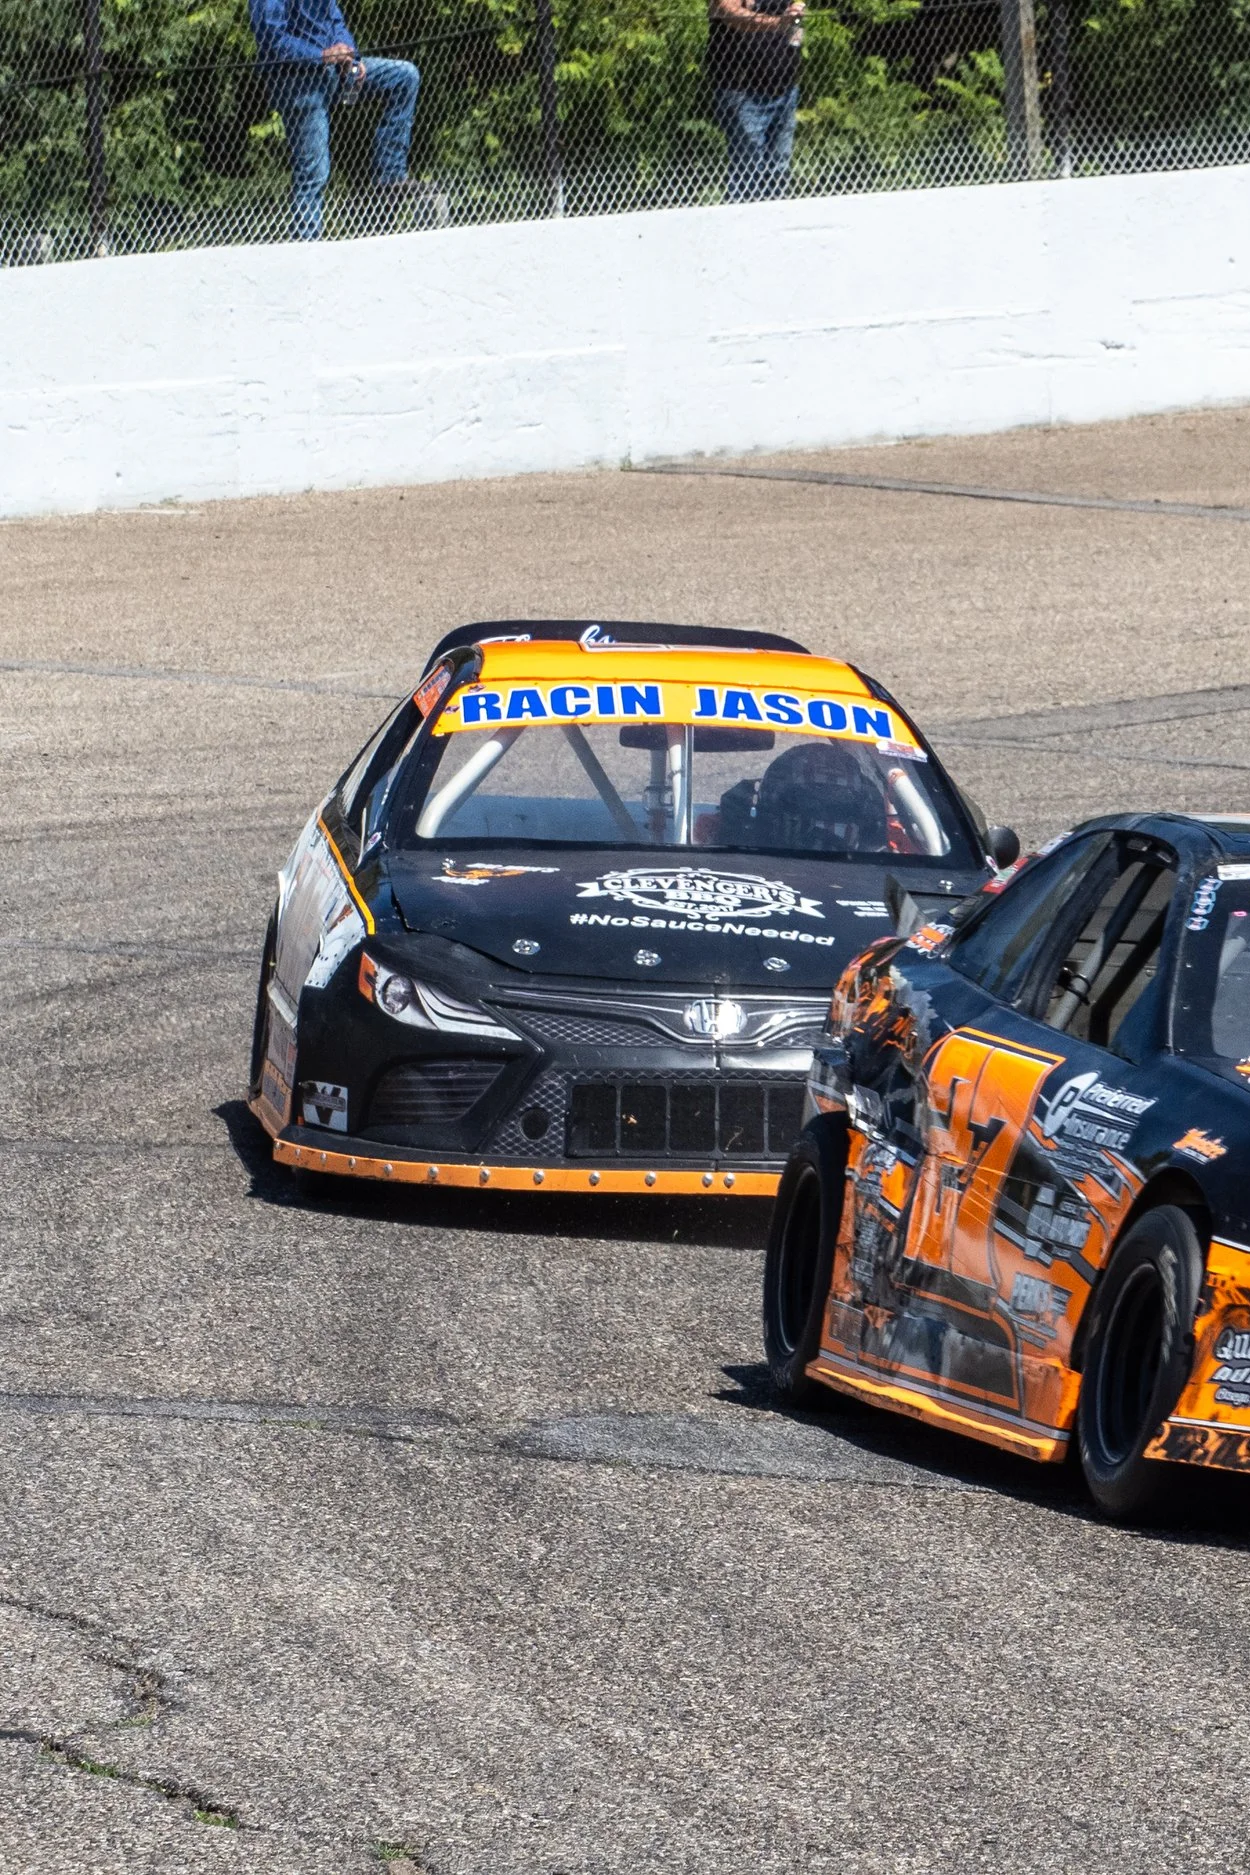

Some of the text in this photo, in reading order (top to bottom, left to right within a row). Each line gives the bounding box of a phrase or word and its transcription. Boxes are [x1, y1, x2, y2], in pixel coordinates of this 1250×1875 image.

[460, 685, 894, 739] RACIN JASON
[603, 877, 796, 905] CLEVENGER'S
[664, 890, 742, 907] BBQ
[569, 913, 835, 946] #NoSauceNeeded
[1082, 1081, 1158, 1115] Preferred
